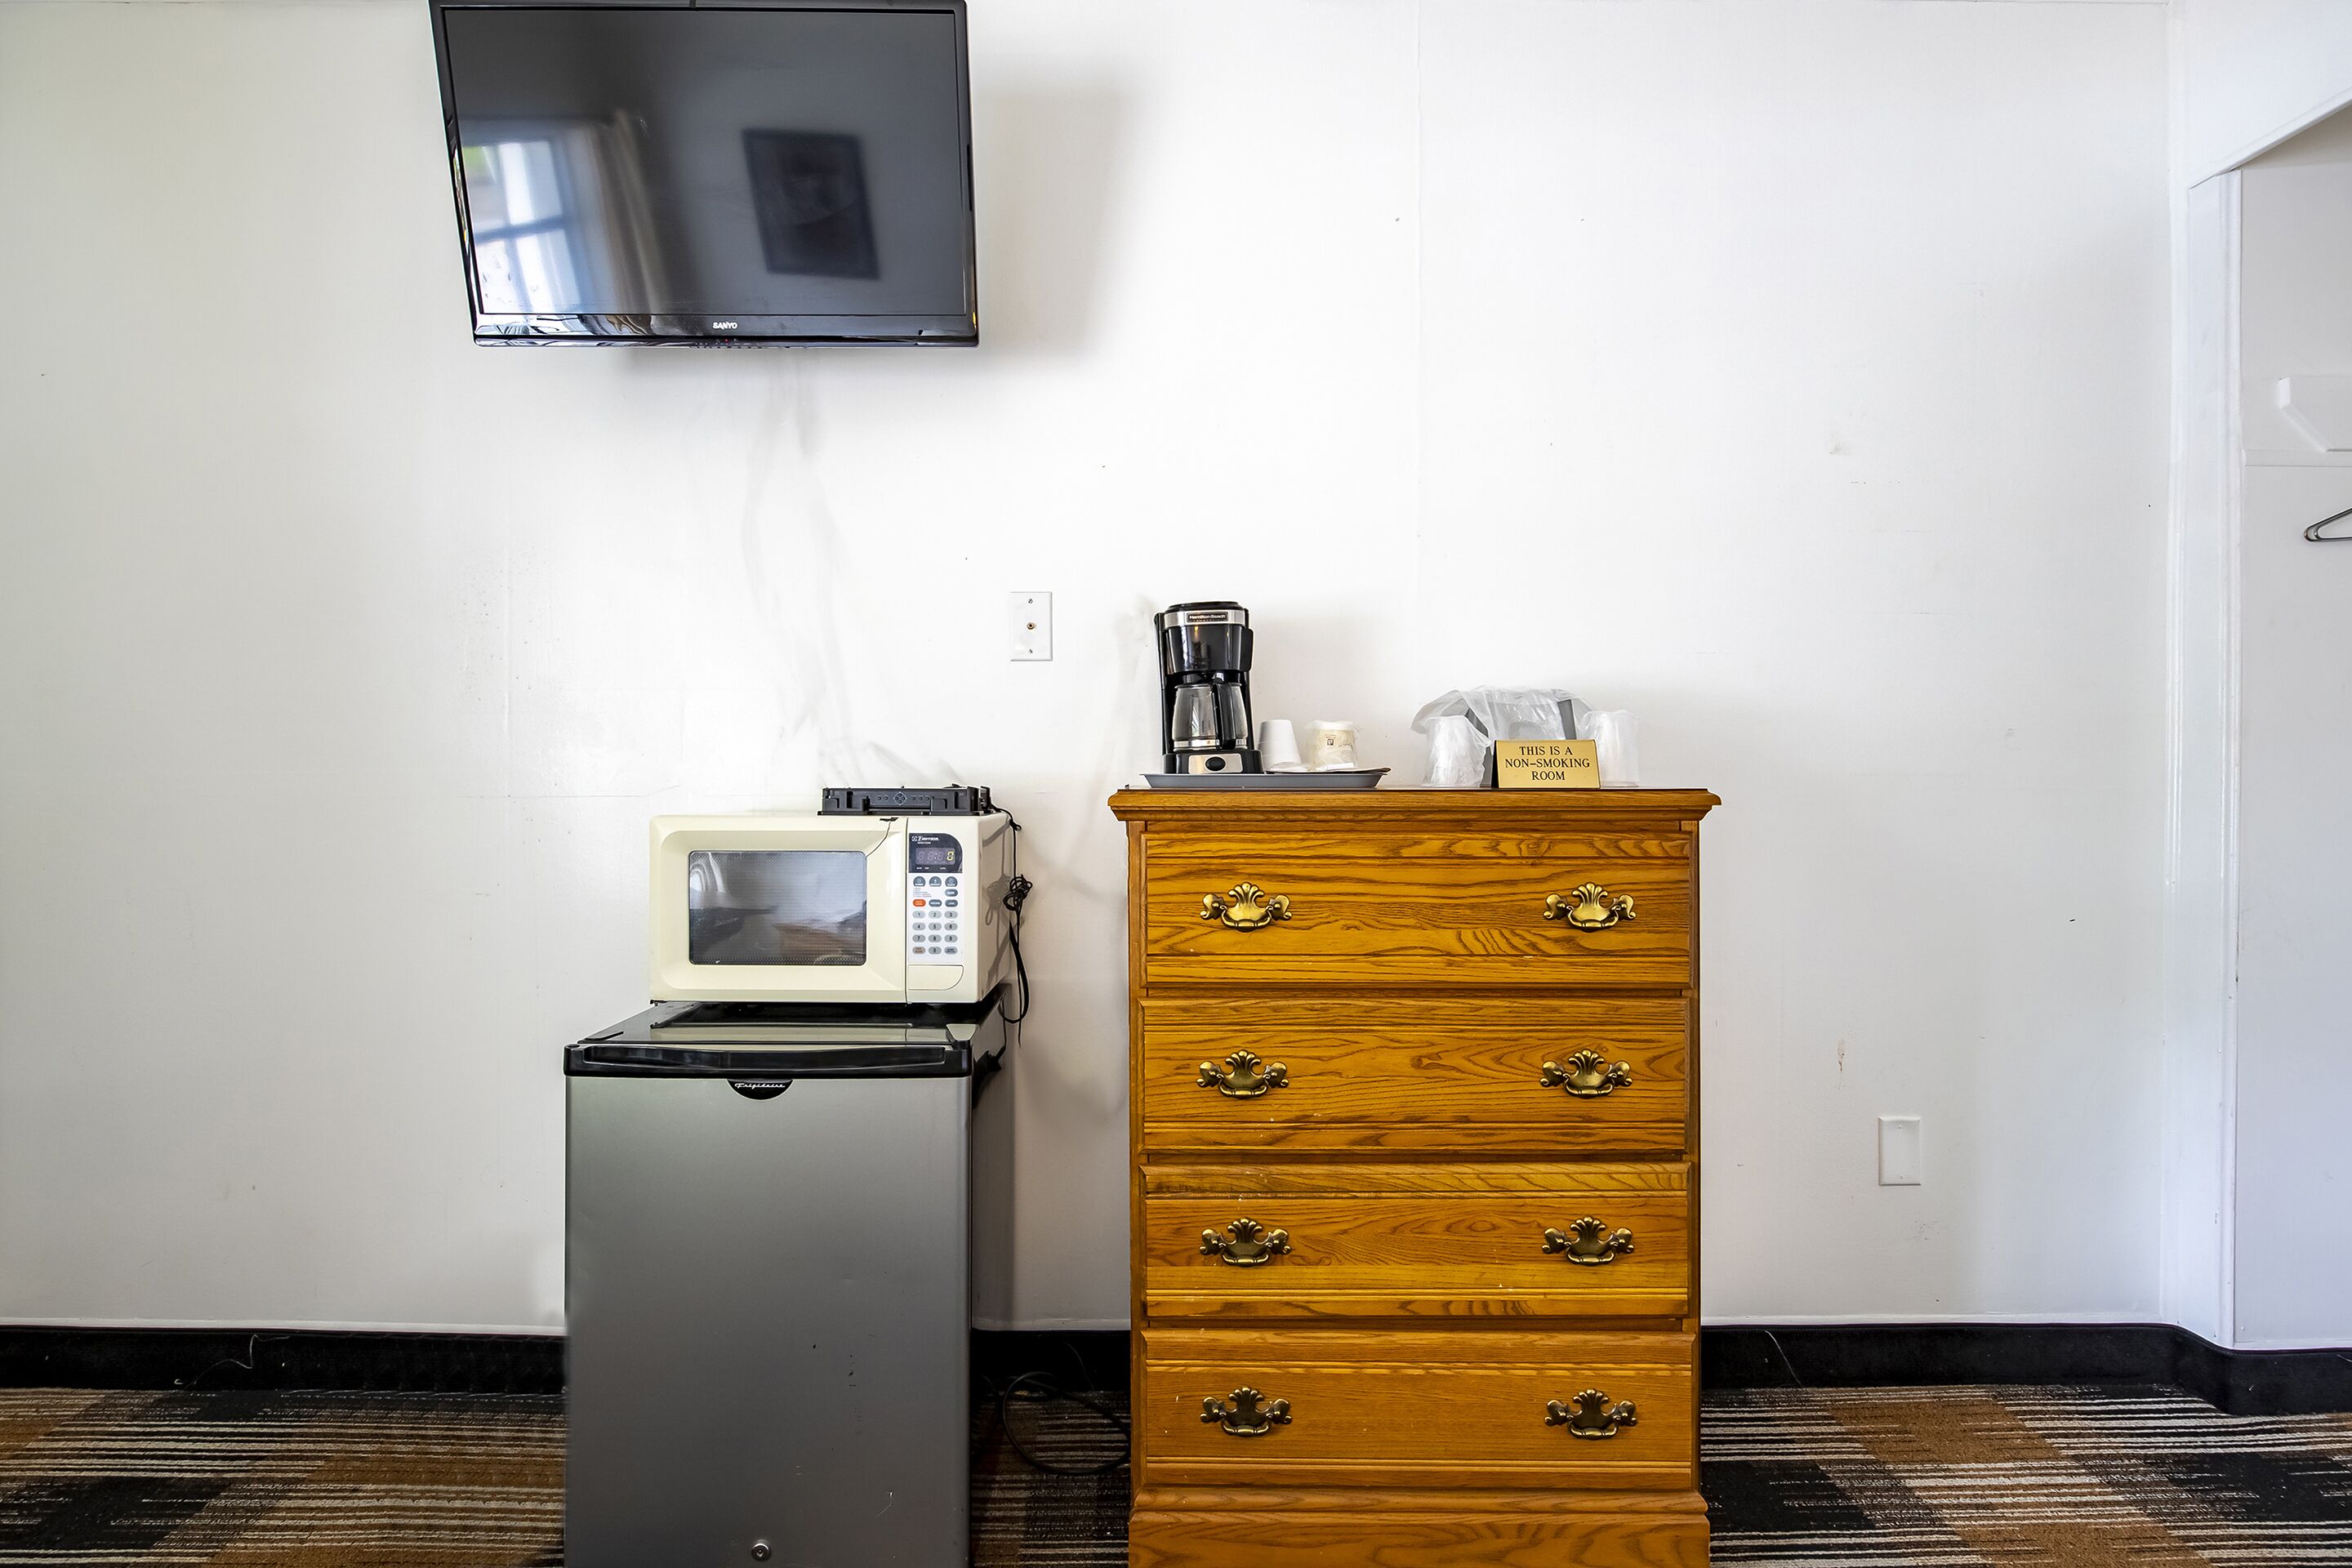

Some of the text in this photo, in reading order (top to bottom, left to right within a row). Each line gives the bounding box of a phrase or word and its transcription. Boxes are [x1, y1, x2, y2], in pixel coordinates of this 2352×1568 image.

[1519, 746, 1573, 755] THIS IS A
[1505, 758, 1590, 768] NON-SMOKING
[1531, 771, 1566, 781] ROOM
